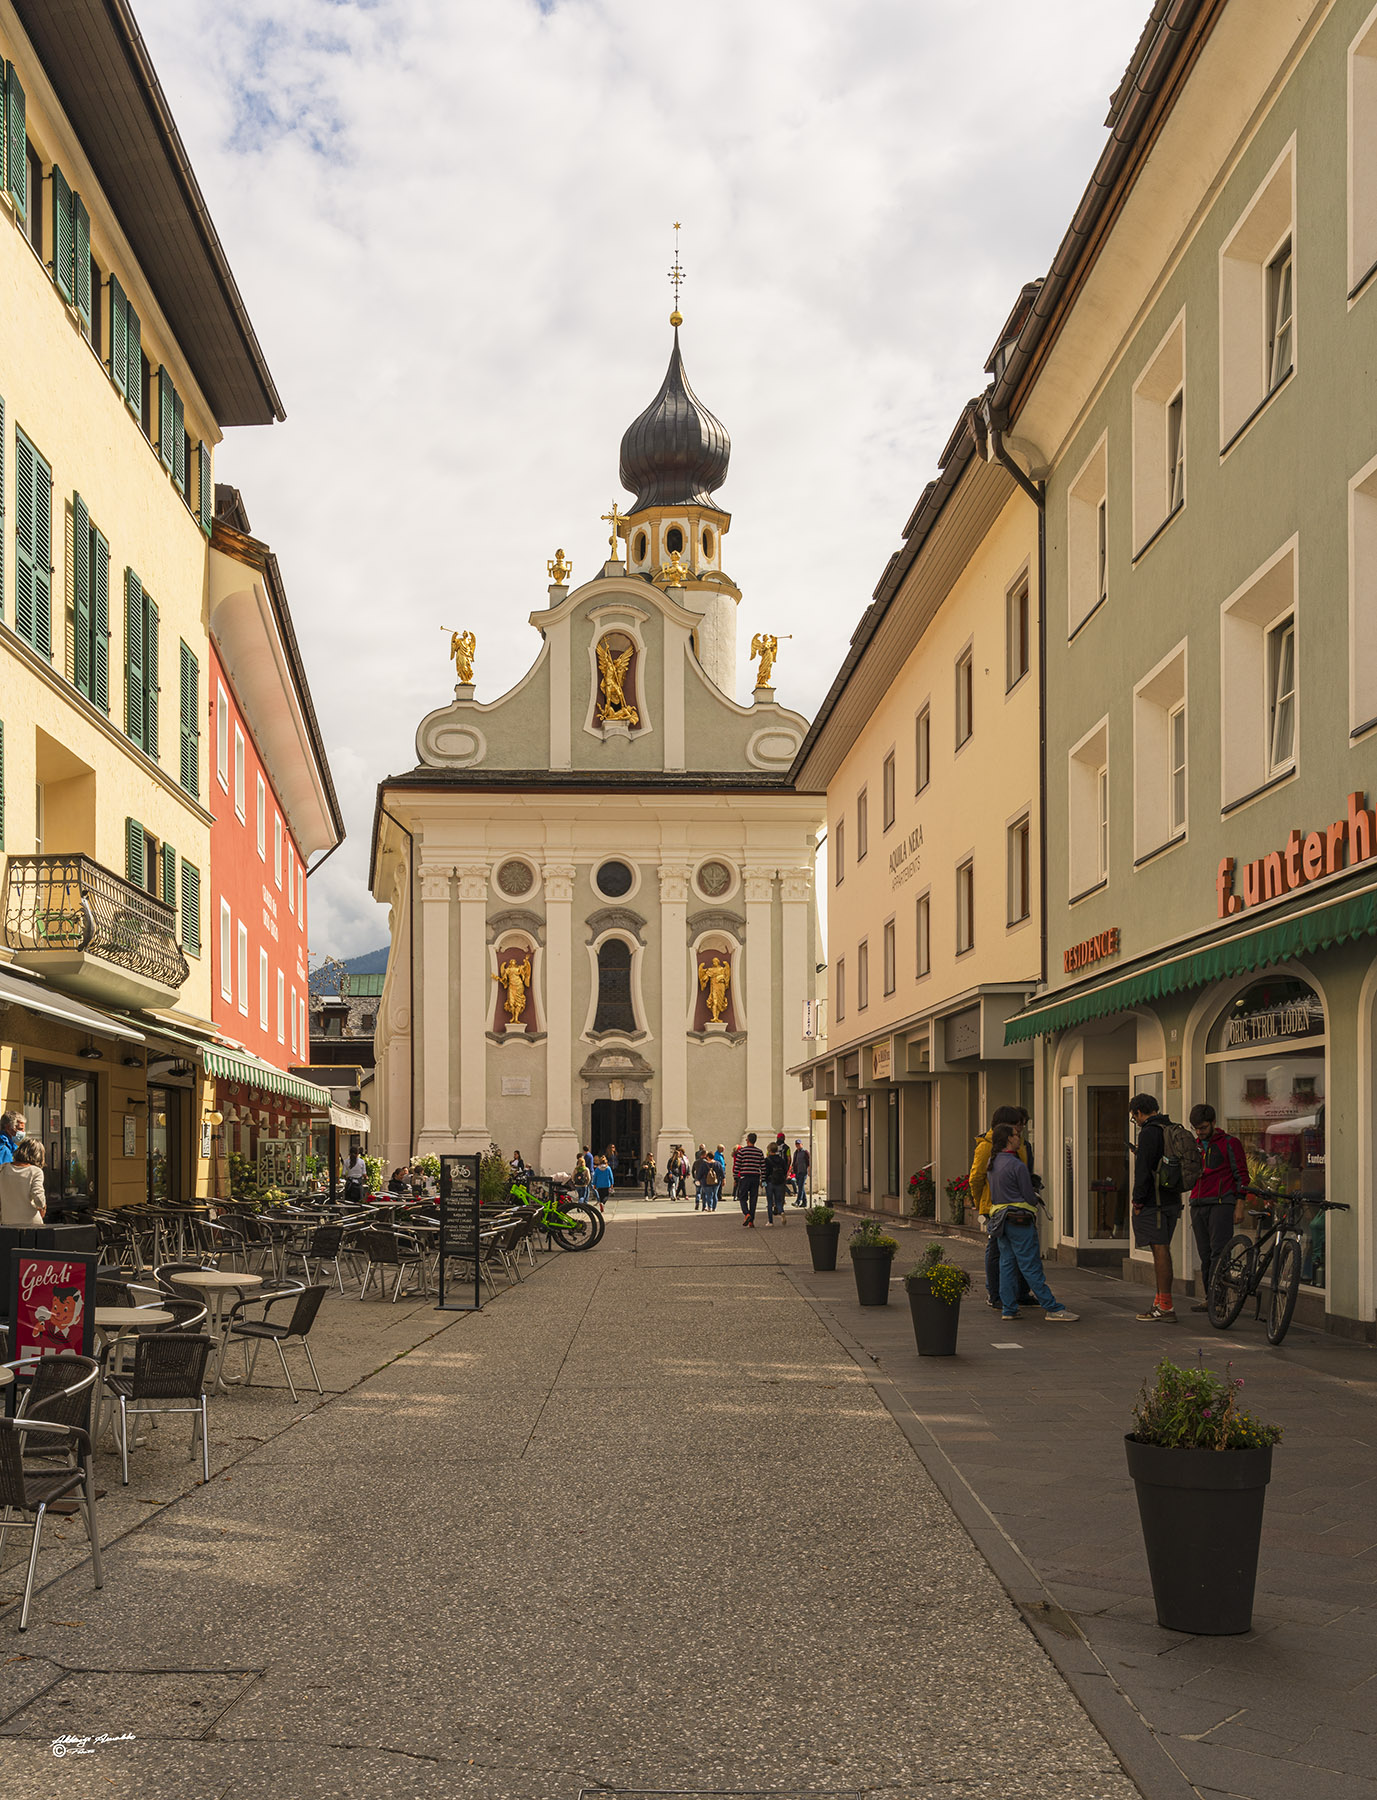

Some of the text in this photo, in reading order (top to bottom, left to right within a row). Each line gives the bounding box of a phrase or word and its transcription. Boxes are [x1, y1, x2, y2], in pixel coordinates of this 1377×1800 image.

[908, 823, 924, 856] NERA
[1216, 791, 1377, 919] f.unterh
[1063, 927, 1119, 974] RESIDENCE
[1229, 1006, 1310, 1045] ORIG. TYROL LODEN
[1307, 1152, 1326, 1165] f.unter
[21, 1263, 73, 1301] Gelati
